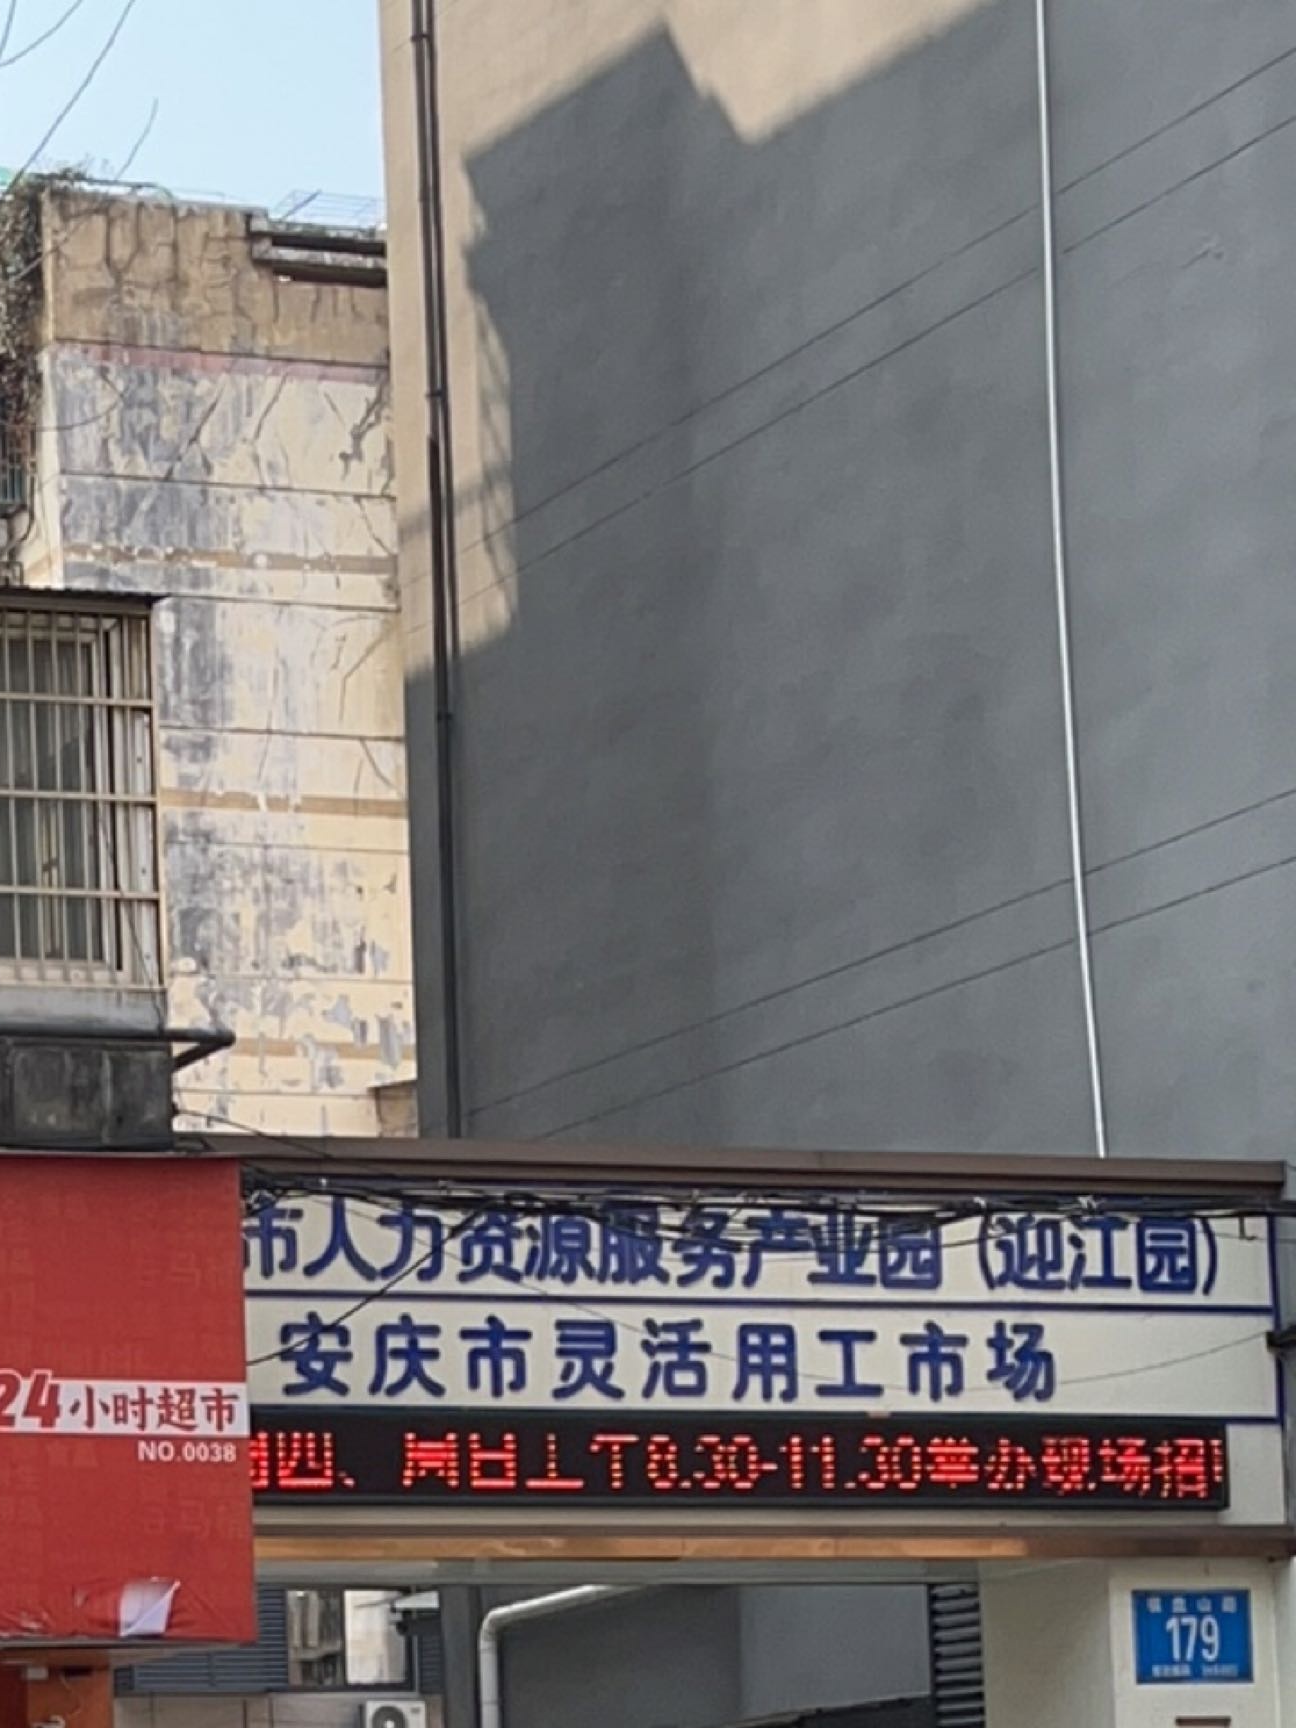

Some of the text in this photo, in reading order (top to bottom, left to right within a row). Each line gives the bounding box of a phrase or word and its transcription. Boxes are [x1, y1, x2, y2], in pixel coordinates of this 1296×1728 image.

[279, 1312, 1056, 1402] 安庆市灵活用工市场
[137, 1441, 237, 1463] NO.0038
[1166, 1615, 1220, 1662] 179
